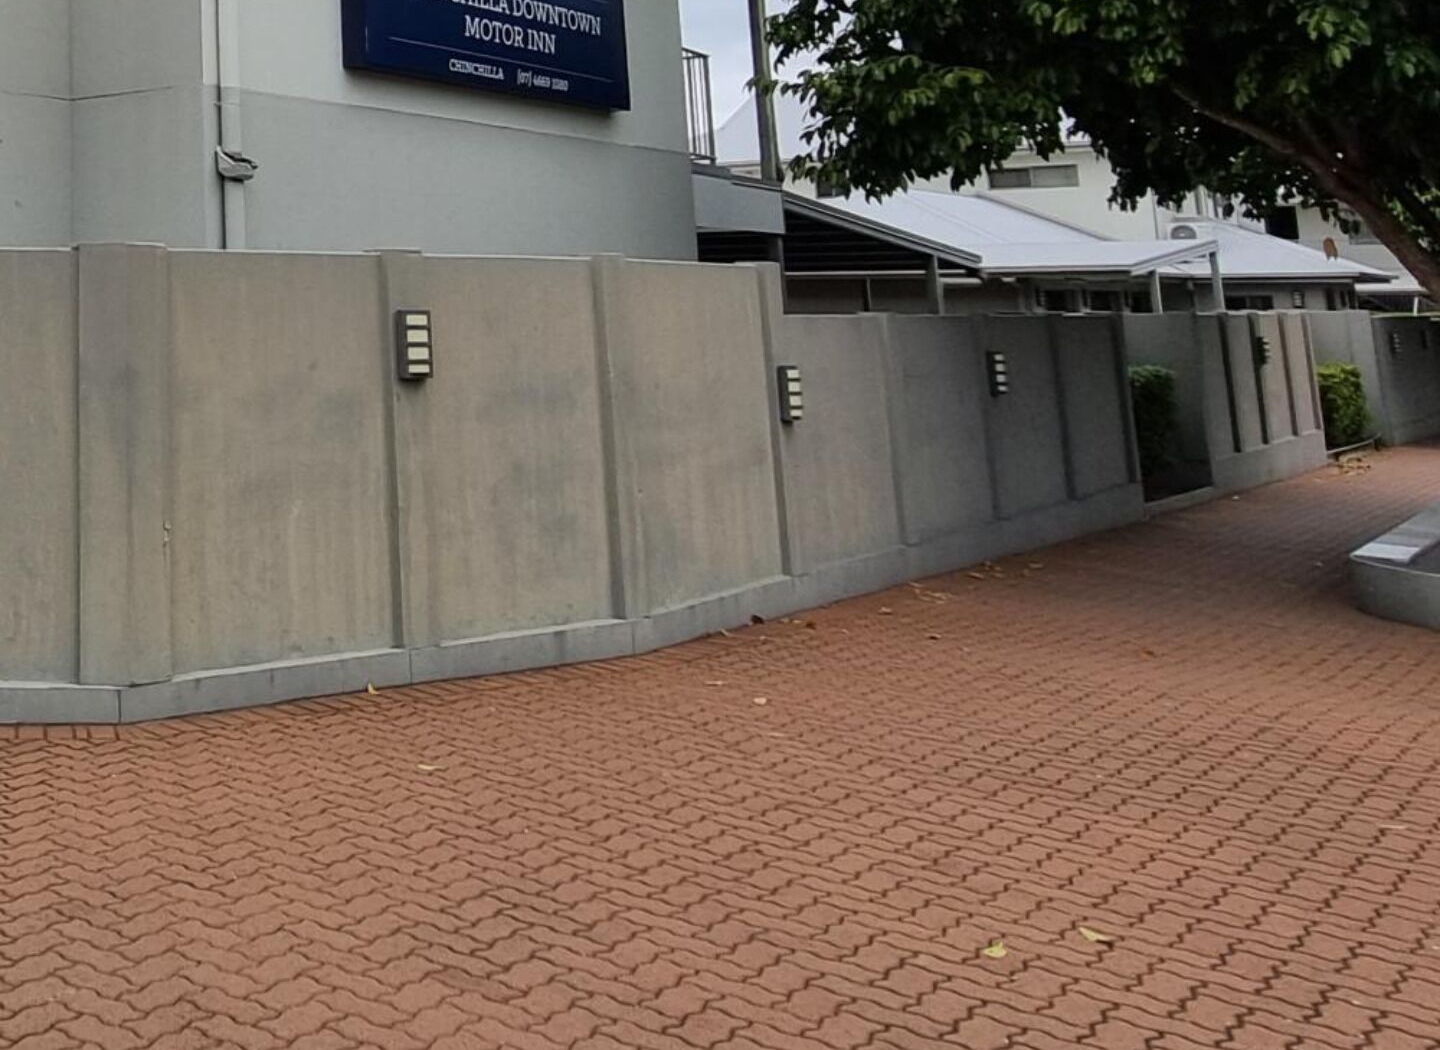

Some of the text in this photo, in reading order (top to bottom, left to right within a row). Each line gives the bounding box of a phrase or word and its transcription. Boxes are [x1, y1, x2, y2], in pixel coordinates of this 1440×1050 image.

[464, 14, 557, 55] MOTOR INN
[448, 58, 505, 80] CHINCHILLA
